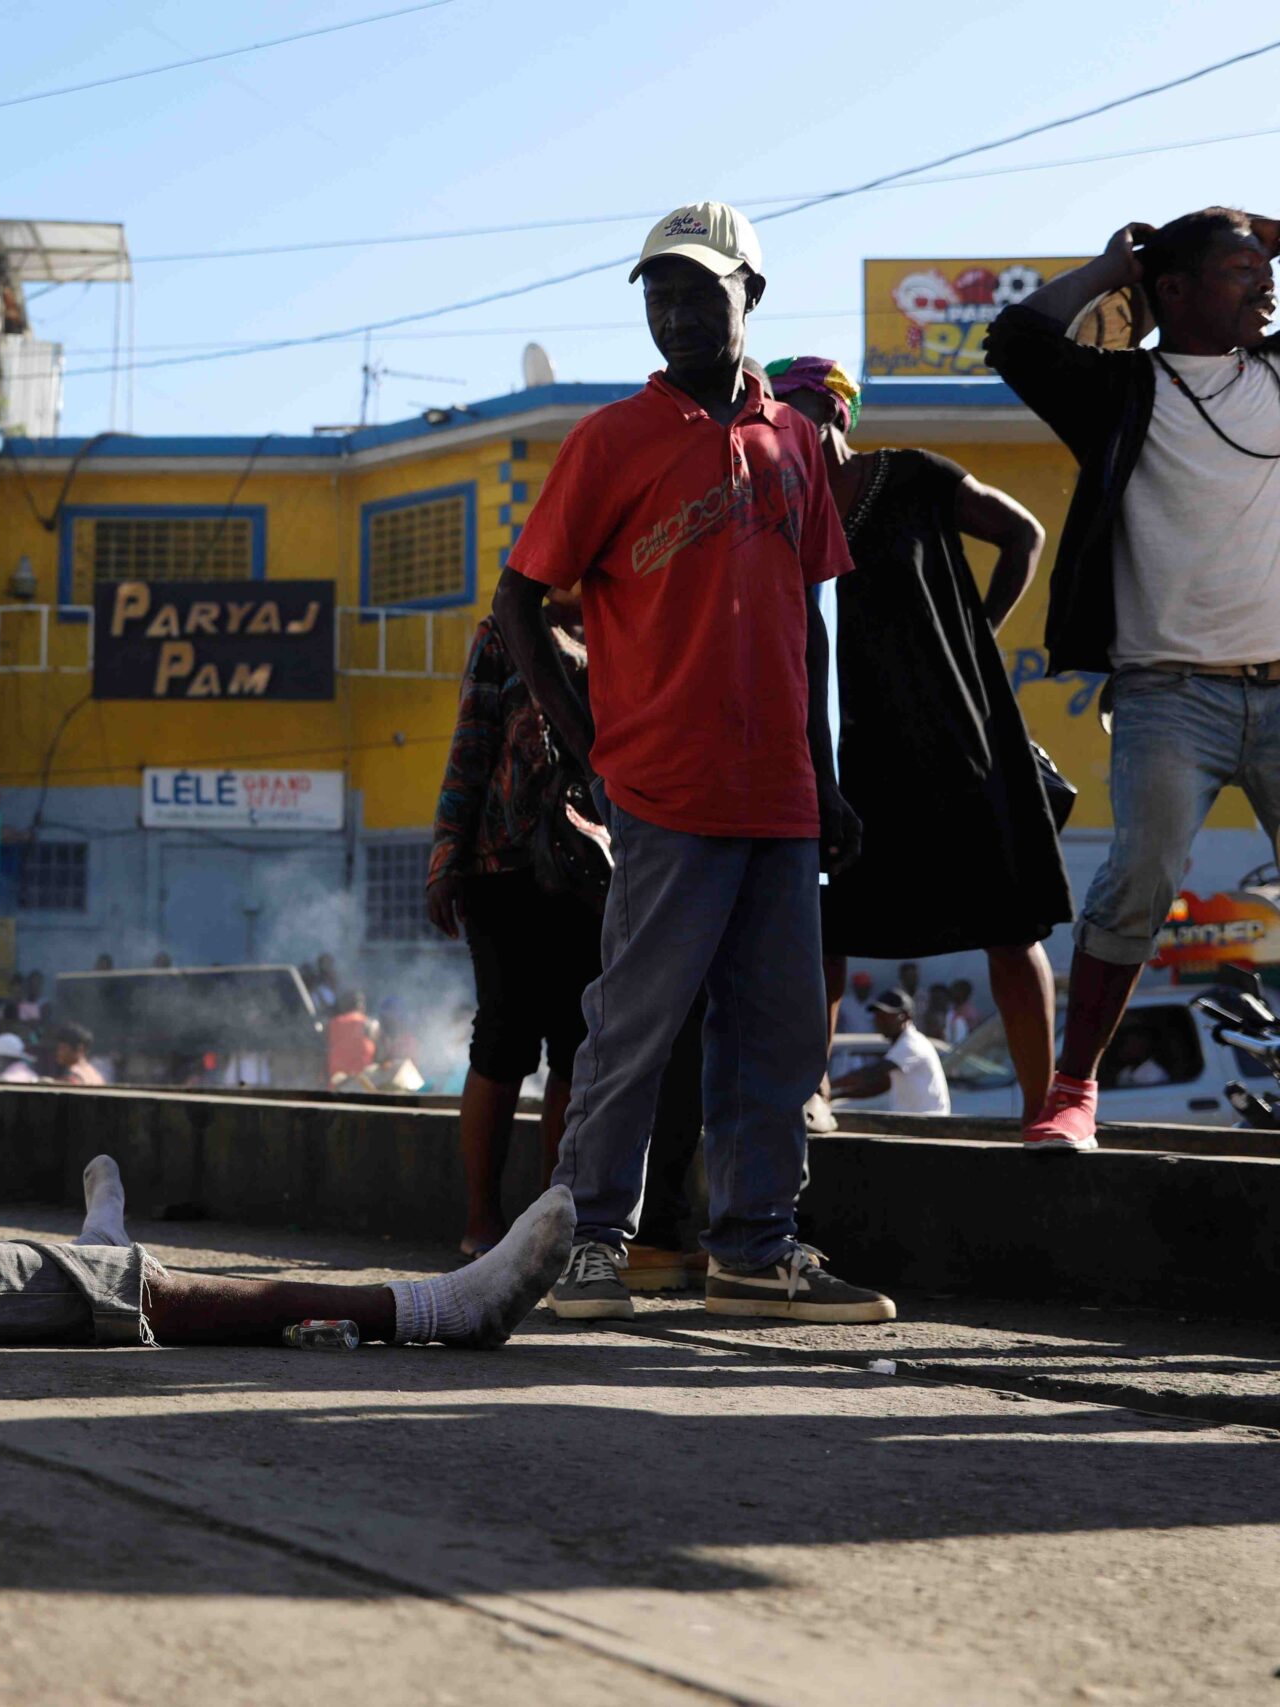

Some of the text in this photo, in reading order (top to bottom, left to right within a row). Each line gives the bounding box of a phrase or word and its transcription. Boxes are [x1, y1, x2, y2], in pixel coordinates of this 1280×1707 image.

[664, 213, 695, 230] Lake
[664, 224, 709, 238] Louise
[111, 581, 320, 637] PARYAJ
[154, 640, 273, 696] PAM
[243, 775, 312, 793] GRAND
